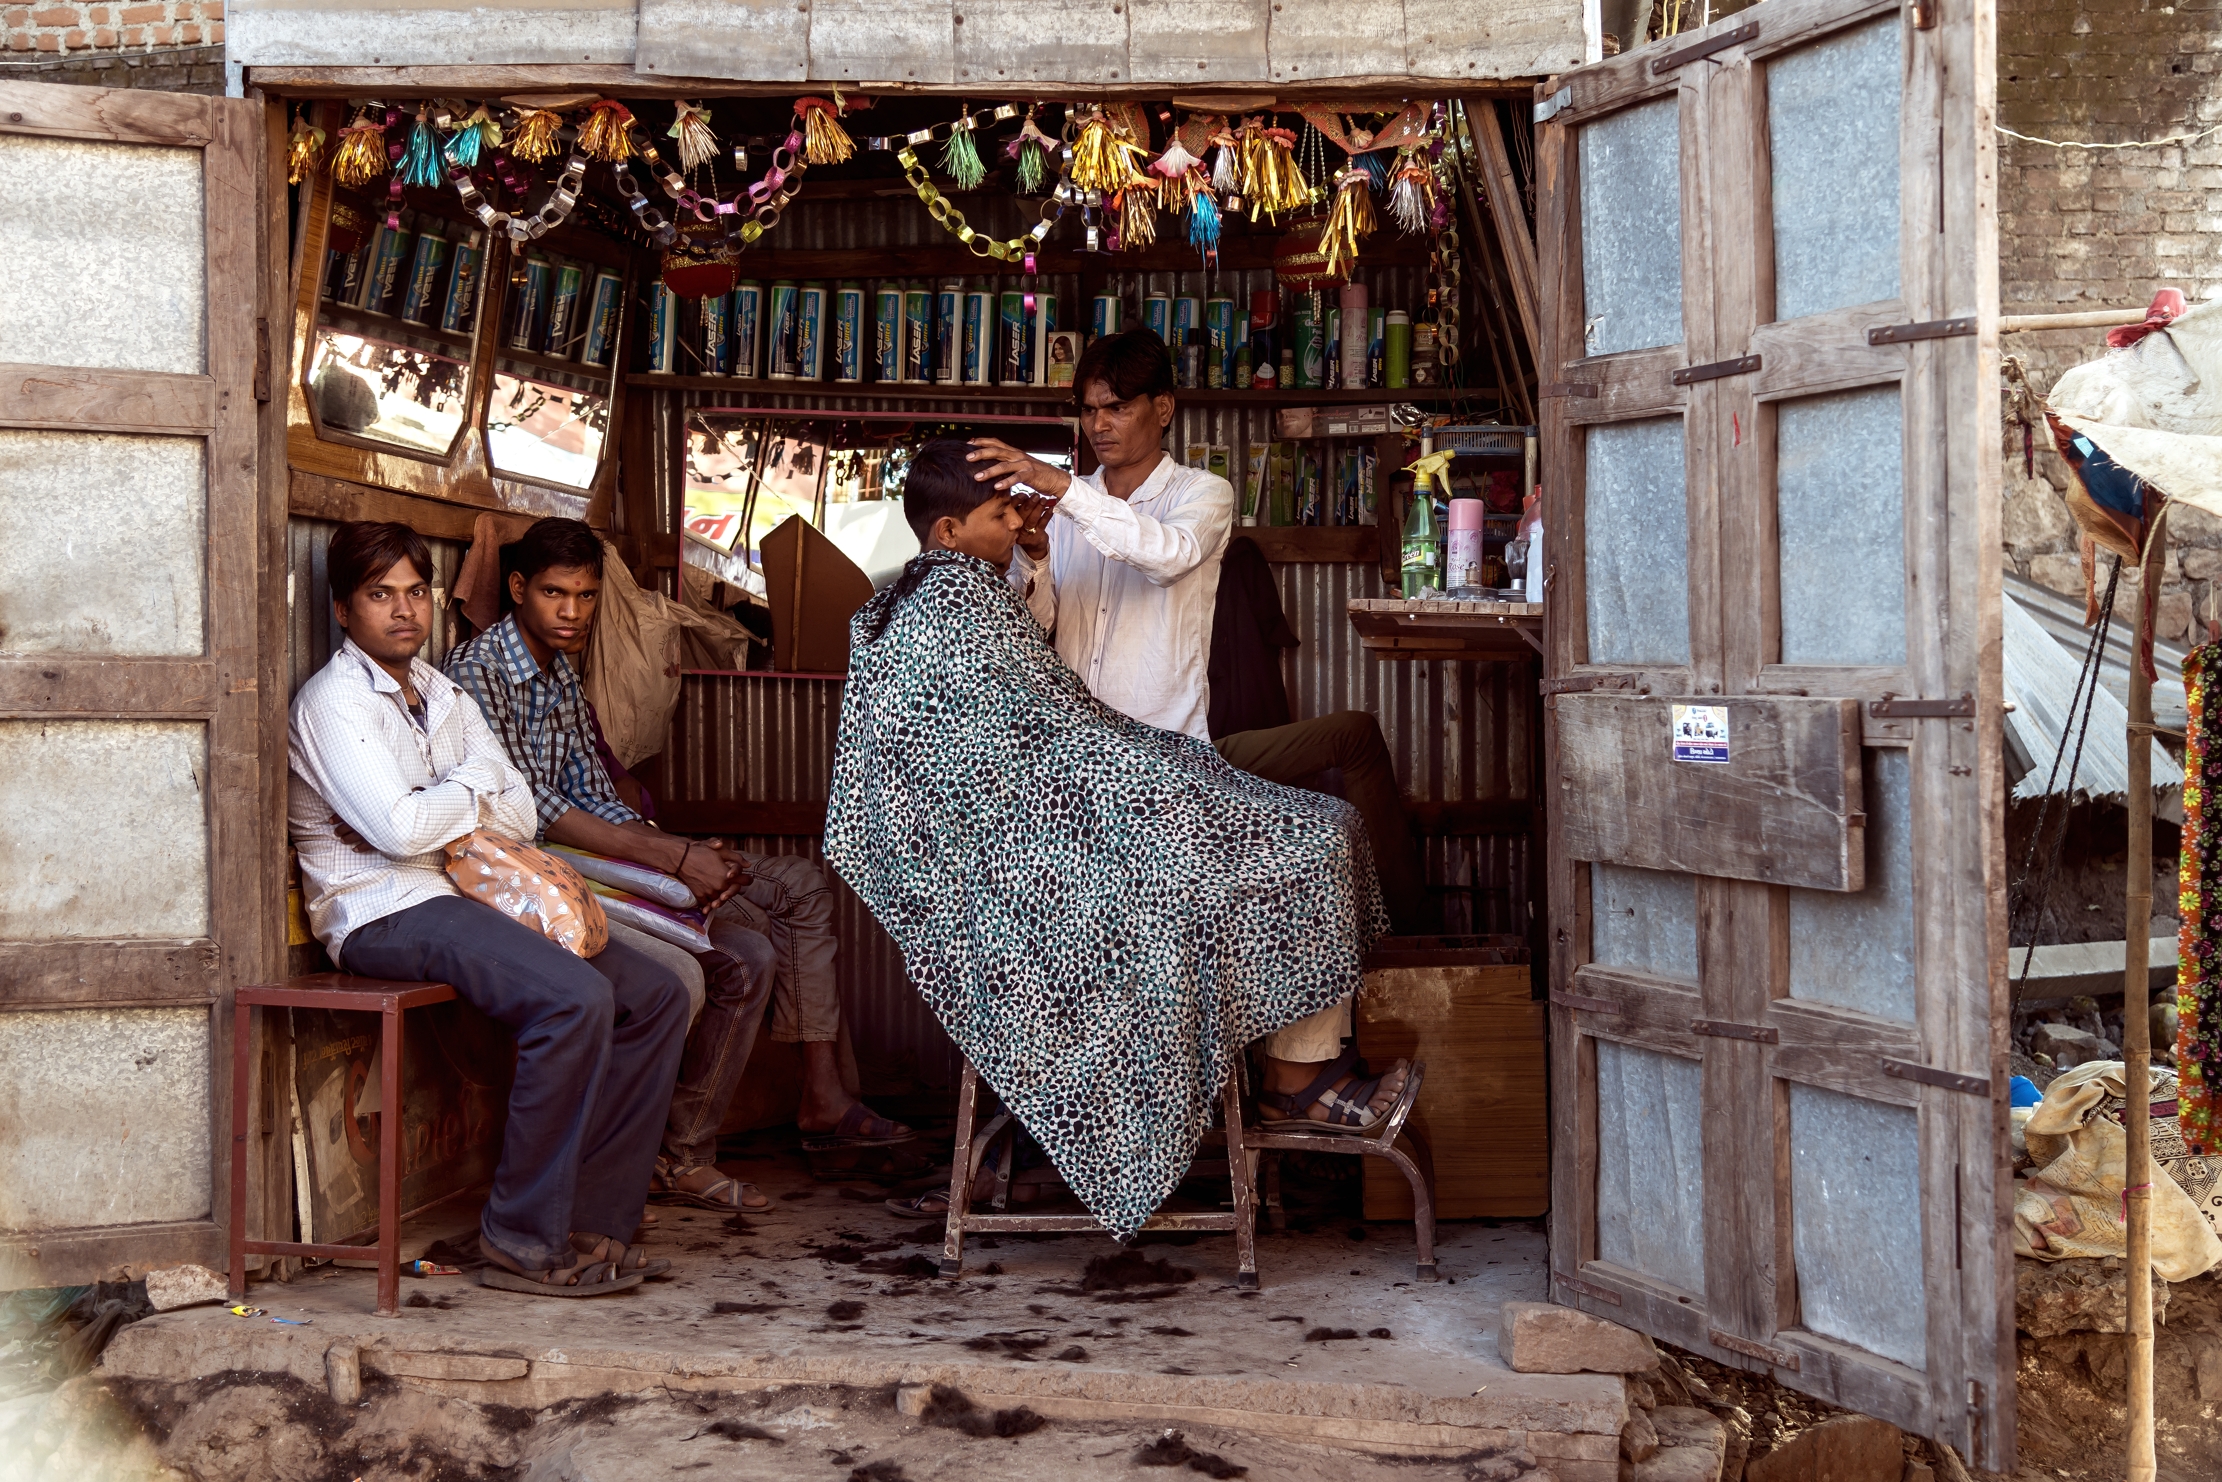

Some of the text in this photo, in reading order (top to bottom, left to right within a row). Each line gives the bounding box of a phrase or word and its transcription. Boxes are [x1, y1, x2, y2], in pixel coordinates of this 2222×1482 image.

[705, 312, 717, 357] LASER
[835, 319, 845, 364] LASER
[875, 320, 884, 366] LASER
[910, 319, 923, 366] LASER
[1009, 321, 1022, 367] LASER
[1365, 454, 1375, 494] LASER
[1306, 477, 1316, 517] LASER
